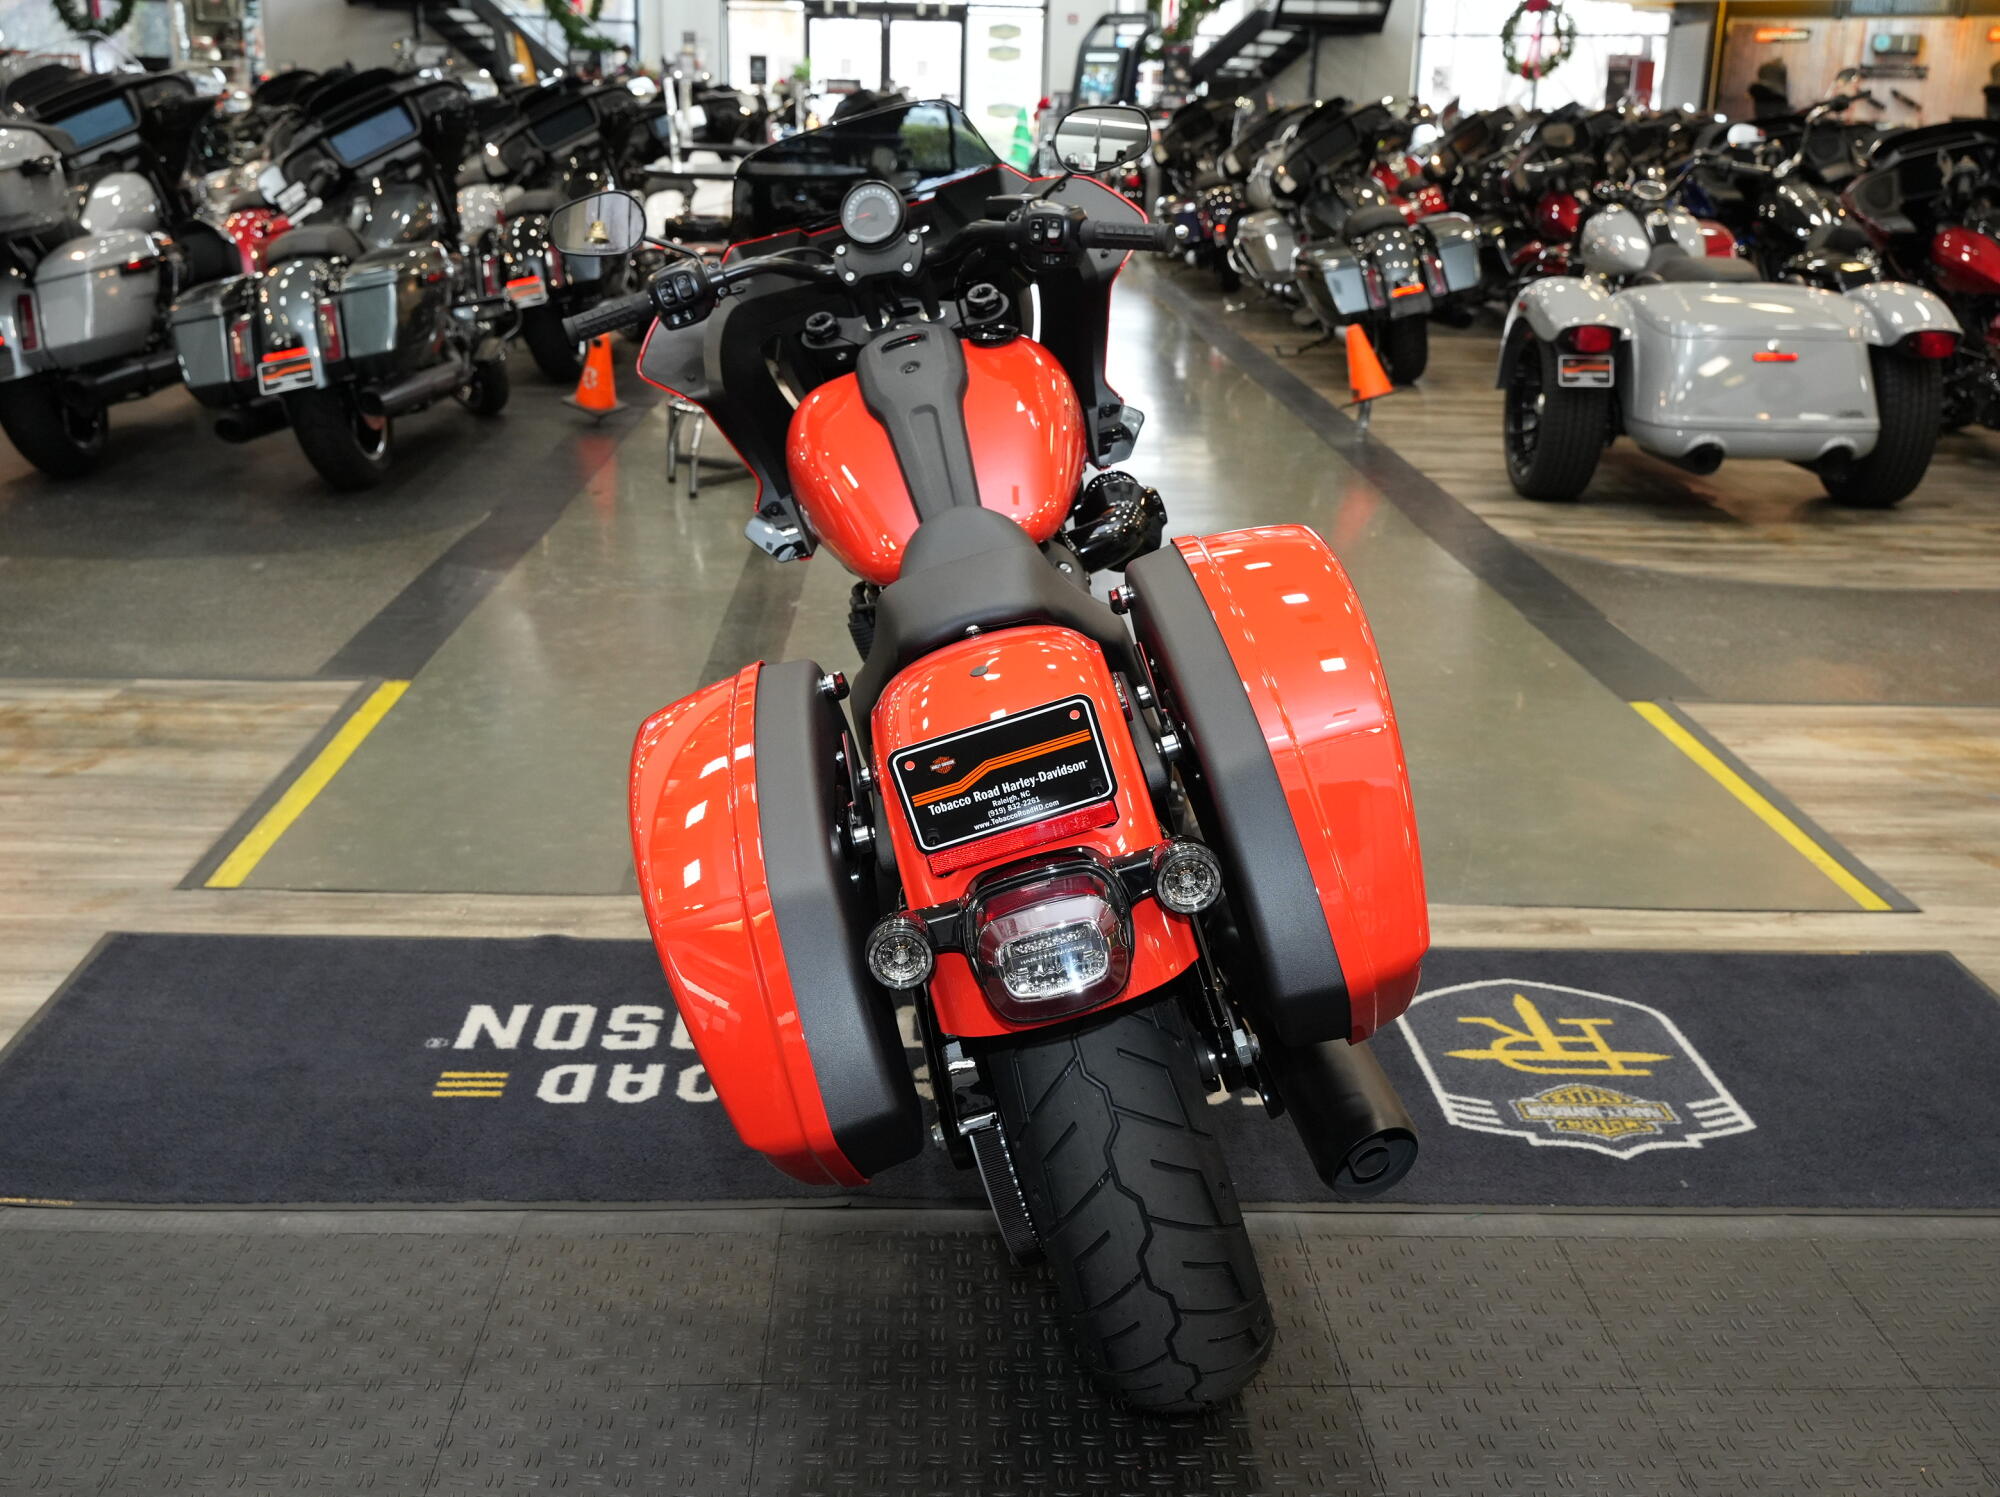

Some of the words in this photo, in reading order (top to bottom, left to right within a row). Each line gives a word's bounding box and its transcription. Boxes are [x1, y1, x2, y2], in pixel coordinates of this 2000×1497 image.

[928, 795, 972, 816] Tobacco
[973, 785, 1000, 803] Road
[1002, 761, 1086, 794] Harley-Davidson
[992, 794, 1018, 808] Raleigh,
[1020, 790, 1031, 799] NC
[974, 800, 1059, 830] www.TobaccoRoadHD.com
[988, 806, 1006, 819] (919)
[1007, 796, 1041, 811] 832-2261
